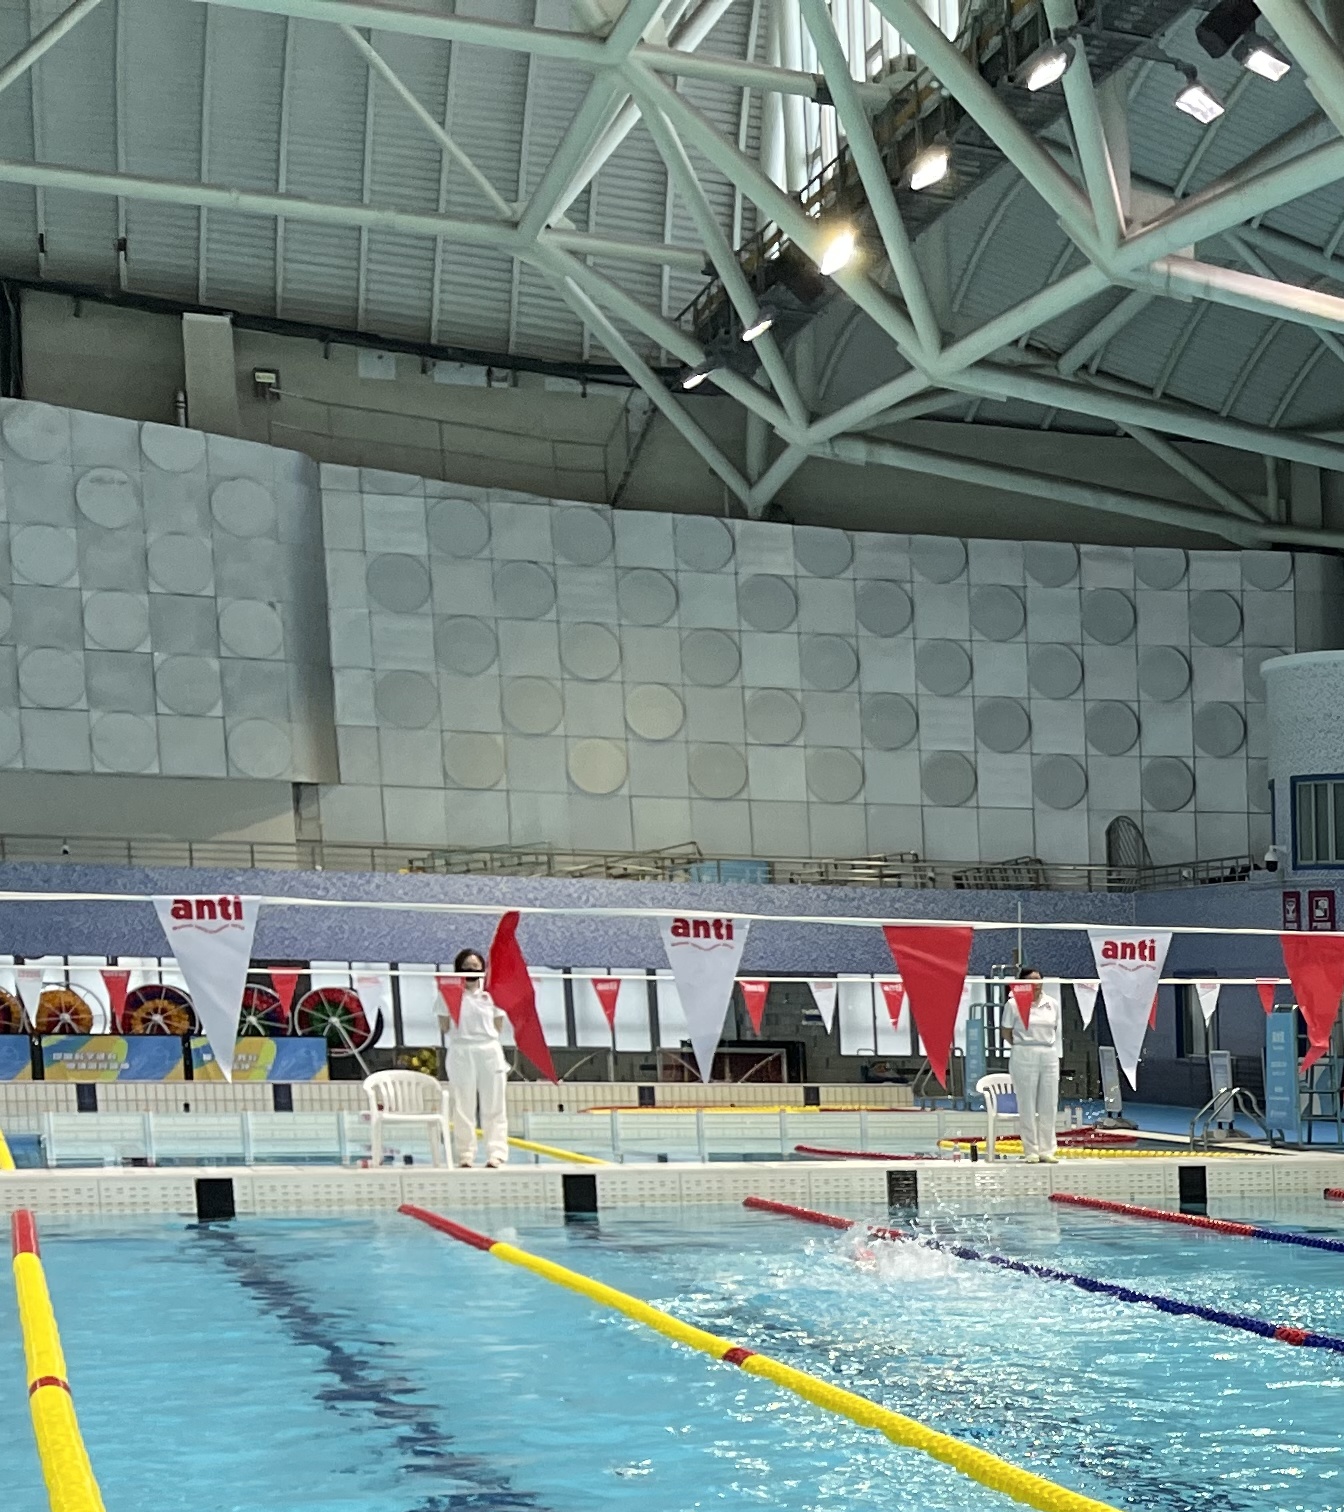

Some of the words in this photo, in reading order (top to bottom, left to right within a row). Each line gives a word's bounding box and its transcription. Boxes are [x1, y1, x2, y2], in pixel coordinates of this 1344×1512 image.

[171, 895, 244, 921] anti
[671, 918, 733, 941] anti
[1101, 938, 1156, 962] anti
